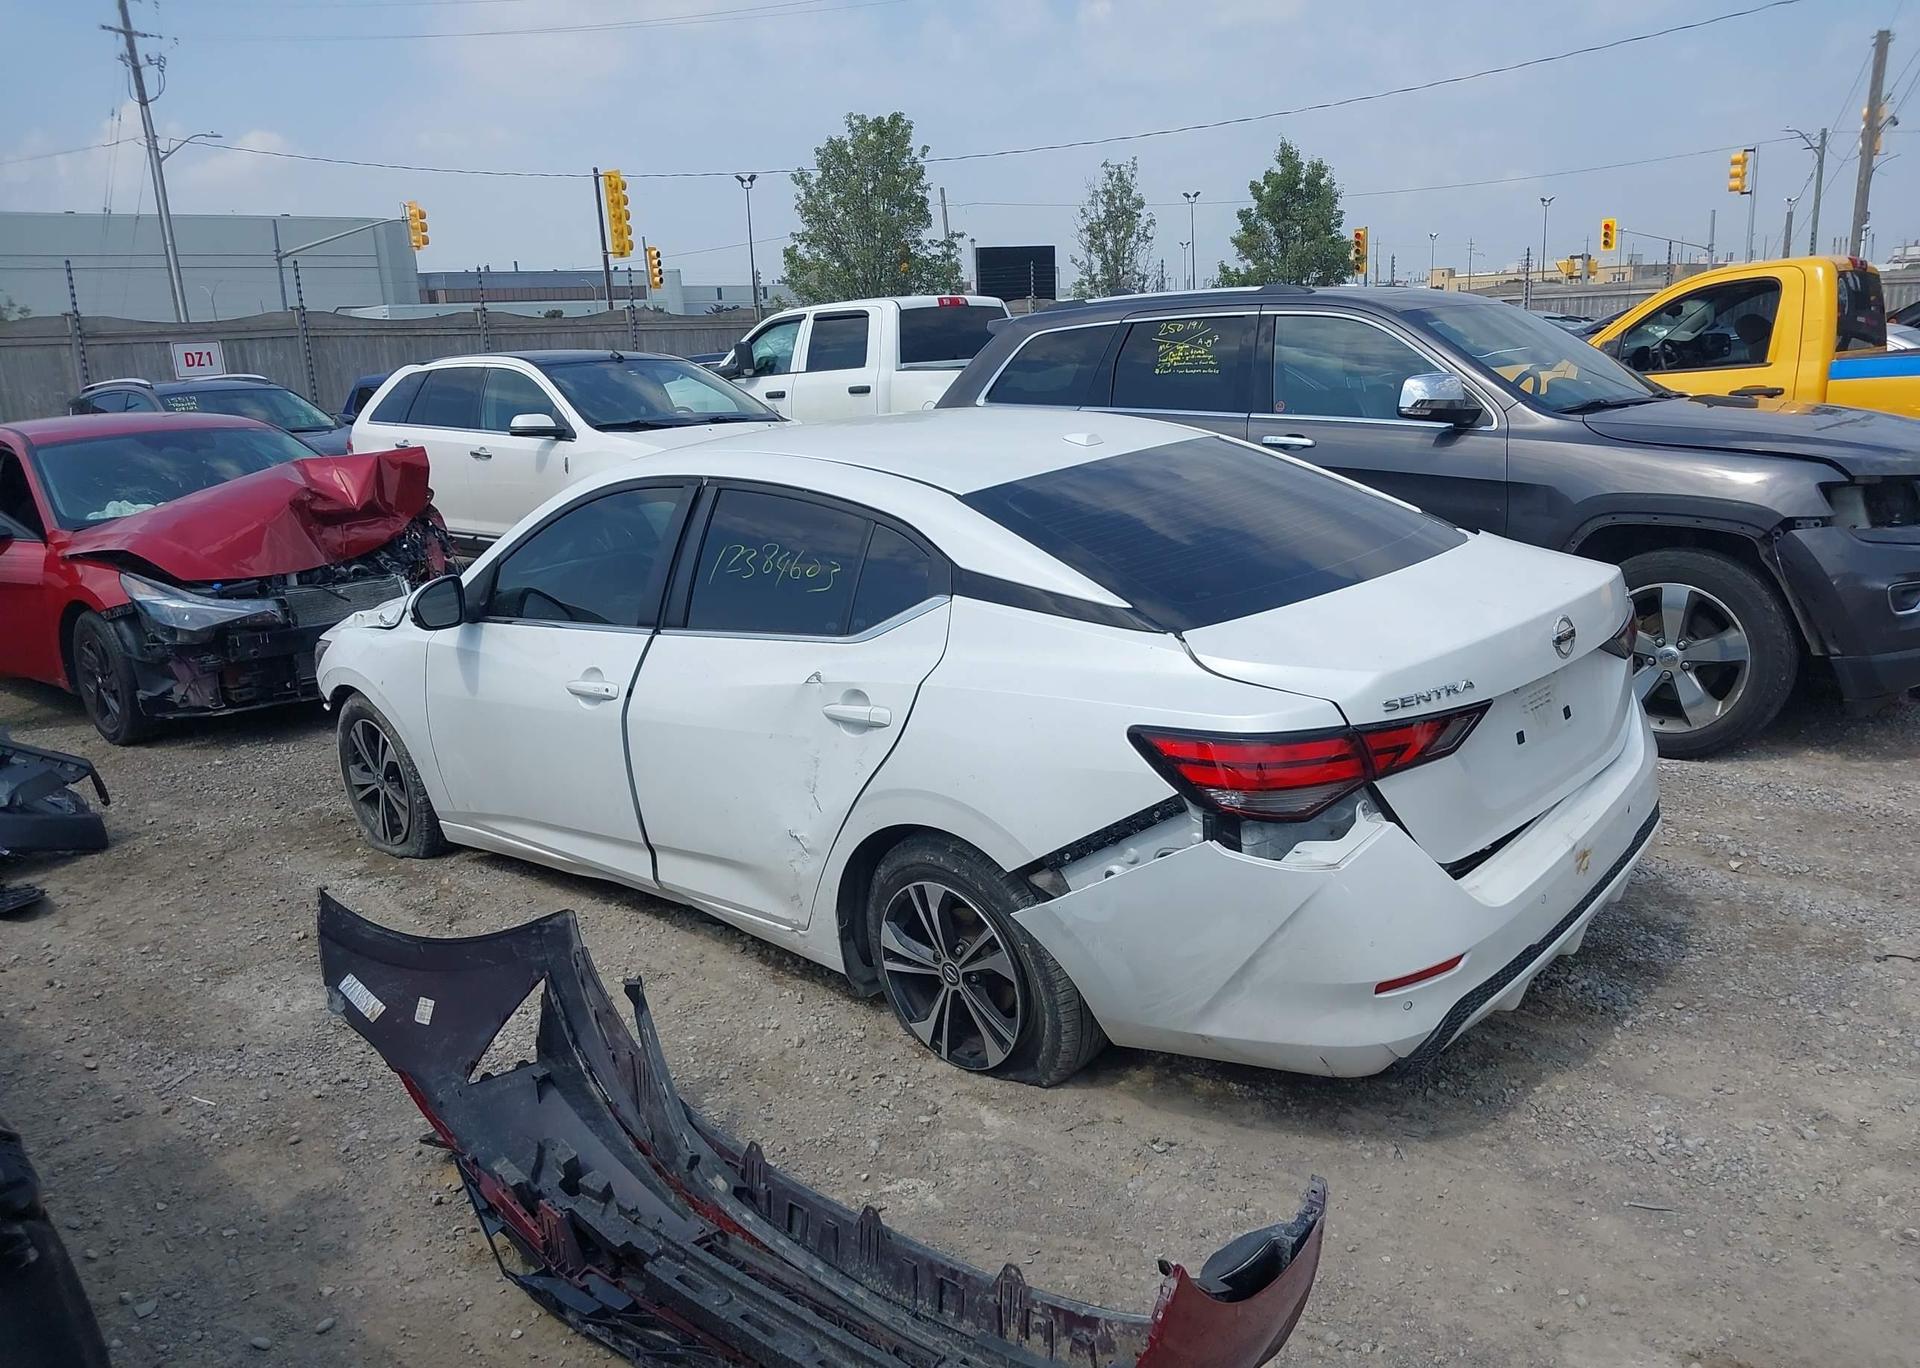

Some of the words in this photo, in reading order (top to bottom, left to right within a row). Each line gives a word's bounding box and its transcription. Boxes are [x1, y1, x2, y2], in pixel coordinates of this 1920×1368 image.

[184, 351, 213, 367] DZ1
[708, 543, 841, 592] 12384603
[1382, 680, 1475, 712] SENTRA
